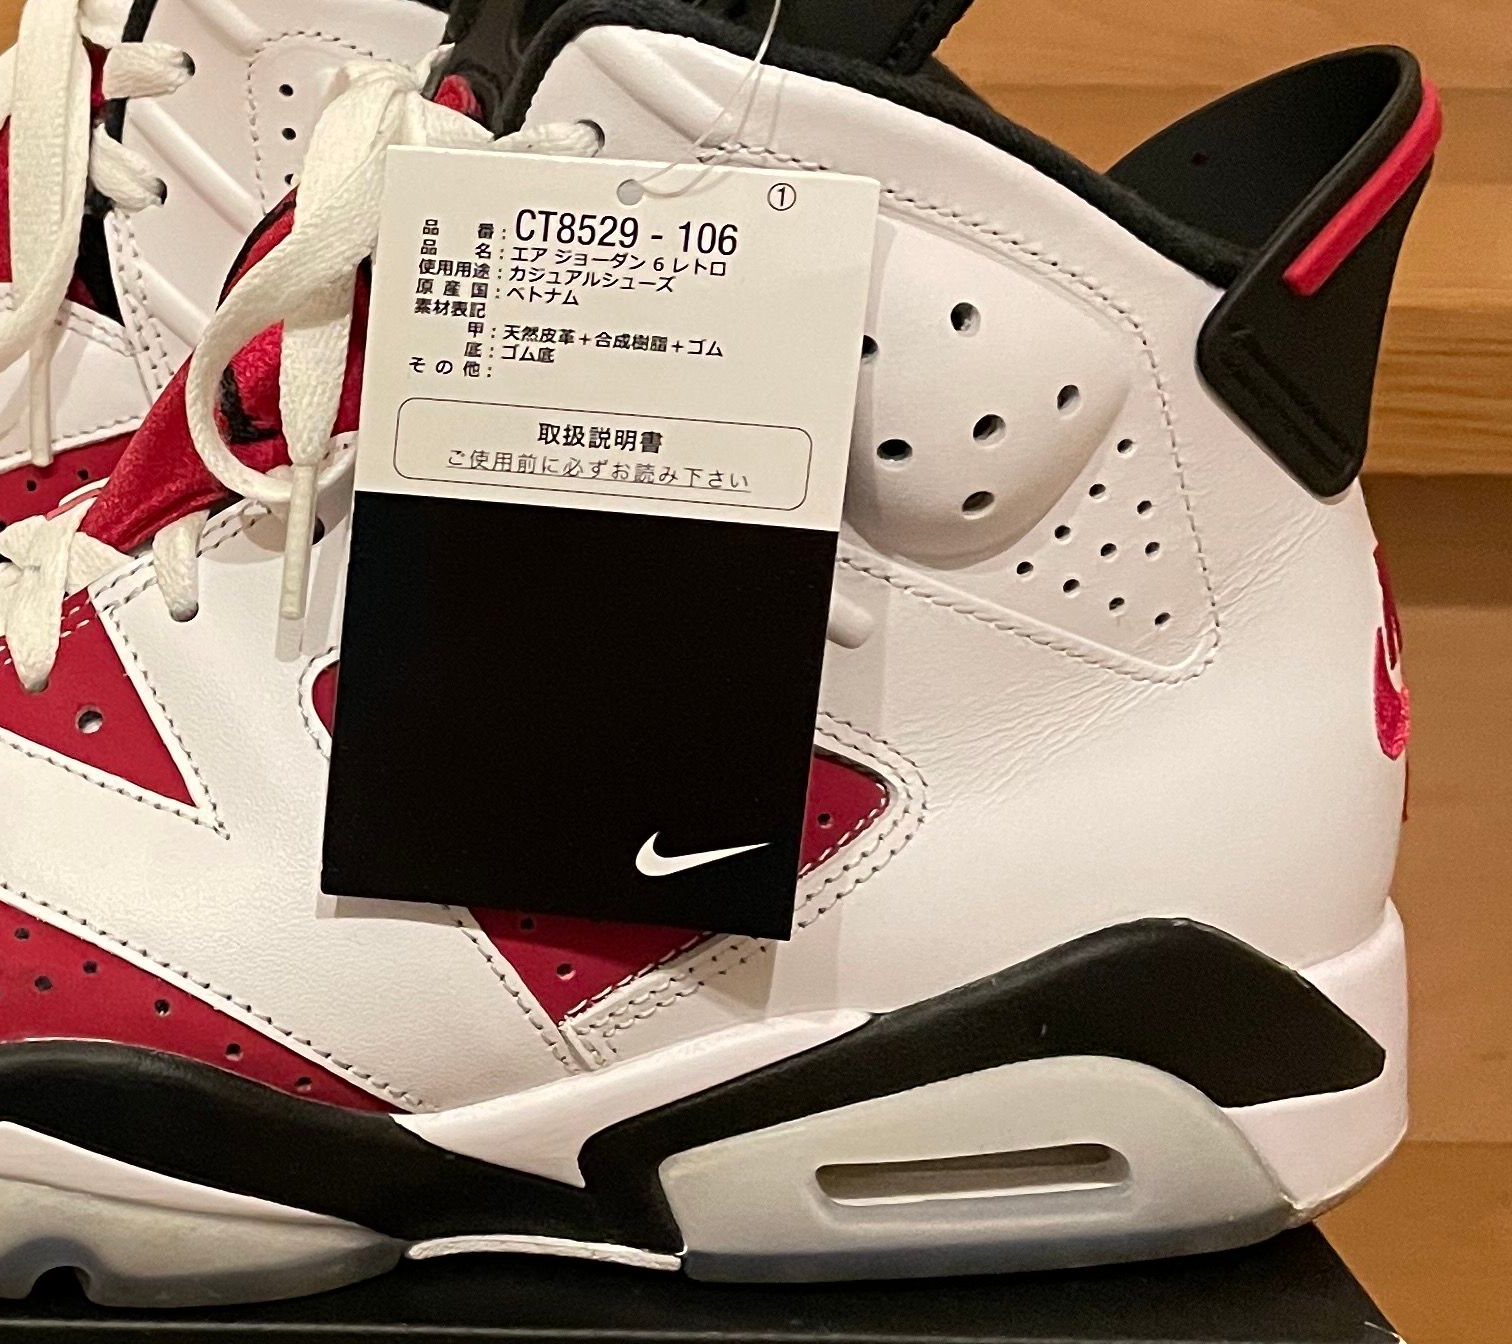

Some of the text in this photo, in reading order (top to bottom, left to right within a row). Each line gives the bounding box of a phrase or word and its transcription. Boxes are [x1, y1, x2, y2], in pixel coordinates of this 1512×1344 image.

[515, 209, 639, 249] CT8529
[678, 221, 738, 256] 106
[537, 422, 664, 454] 取扱説明書
[447, 448, 750, 489] ご使用前に必ずお読み下さい
